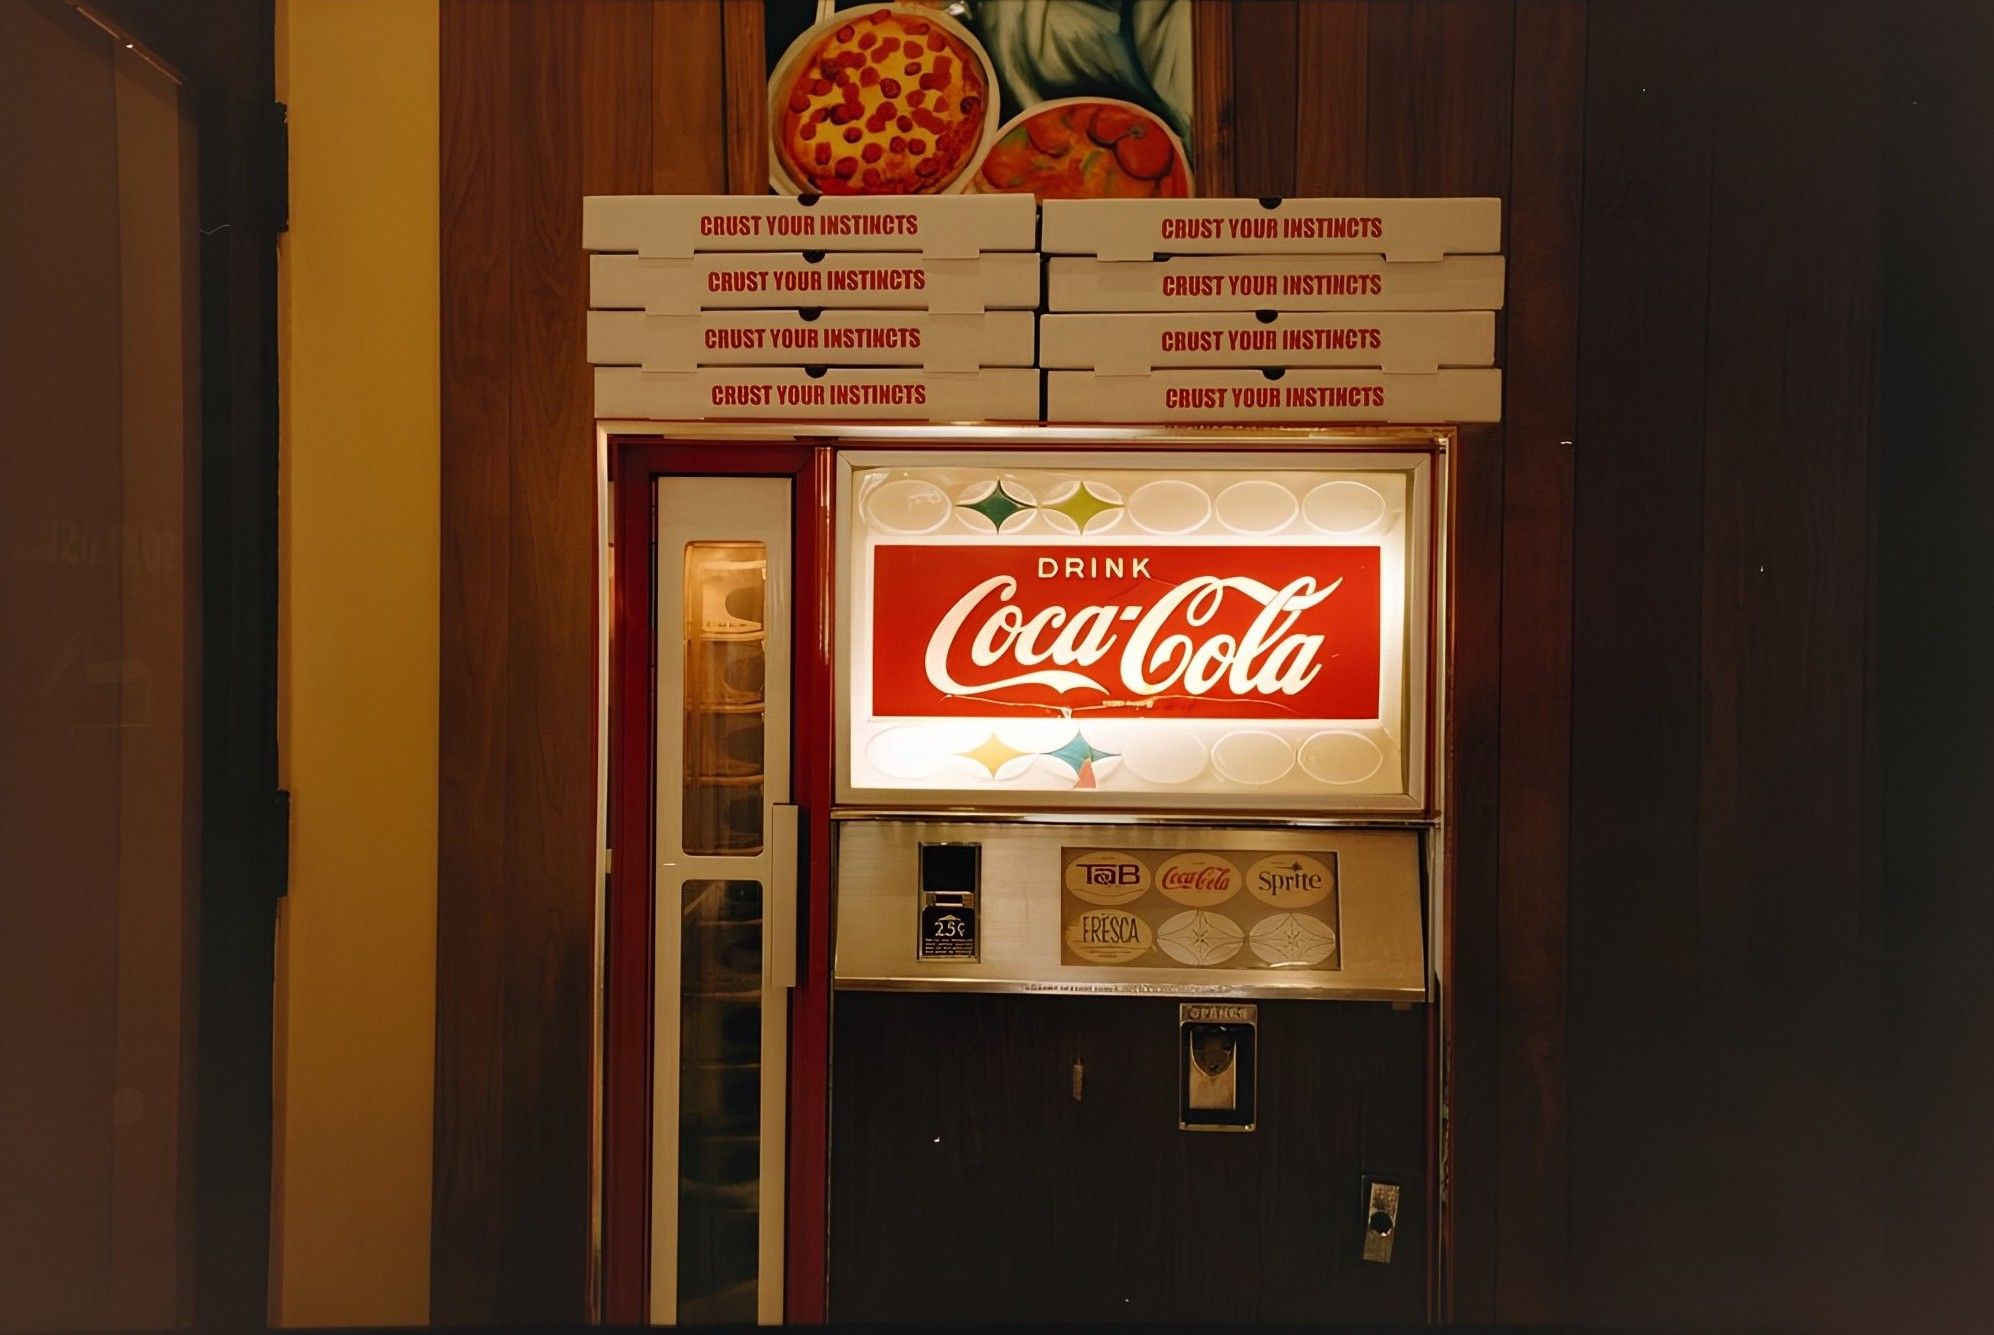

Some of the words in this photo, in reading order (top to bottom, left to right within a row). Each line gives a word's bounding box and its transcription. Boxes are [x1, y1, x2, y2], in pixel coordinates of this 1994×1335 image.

[701, 216, 760, 235] CRUST
[768, 216, 814, 235] YOUR
[820, 215, 917, 235] INSTINCTS
[1162, 219, 1222, 239] CRUST
[1230, 219, 1278, 238] YOUR
[1284, 218, 1381, 238] INSTINCTS
[708, 272, 767, 292] CRUST
[774, 271, 821, 291] YOUR
[827, 270, 925, 290] INSTINCTS
[1163, 276, 1223, 296] CRUST
[1229, 275, 1277, 295] YOUR
[1284, 275, 1381, 295] INSTINCTS
[705, 329, 764, 348] CRUST
[771, 329, 818, 348] YOUR
[824, 328, 920, 348] INSTINCTS
[1162, 331, 1222, 351] CRUST
[1228, 331, 1276, 351] YOUR
[1283, 329, 1380, 349] INSTINCTS
[712, 385, 771, 405] CRUST
[777, 385, 824, 405] YOUR
[830, 384, 926, 405] INSTINCTS
[1166, 388, 1226, 408] CRUST
[1232, 388, 1280, 408] YOUR
[1286, 386, 1383, 406] INSTINCTS
[1038, 557, 1152, 579] DRINK
[925, 574, 1344, 697] Coca-Cola
[1258, 870, 1323, 896] Sprite
[934, 921, 966, 937] 25¢
[1082, 915, 1140, 943] FRESCA
